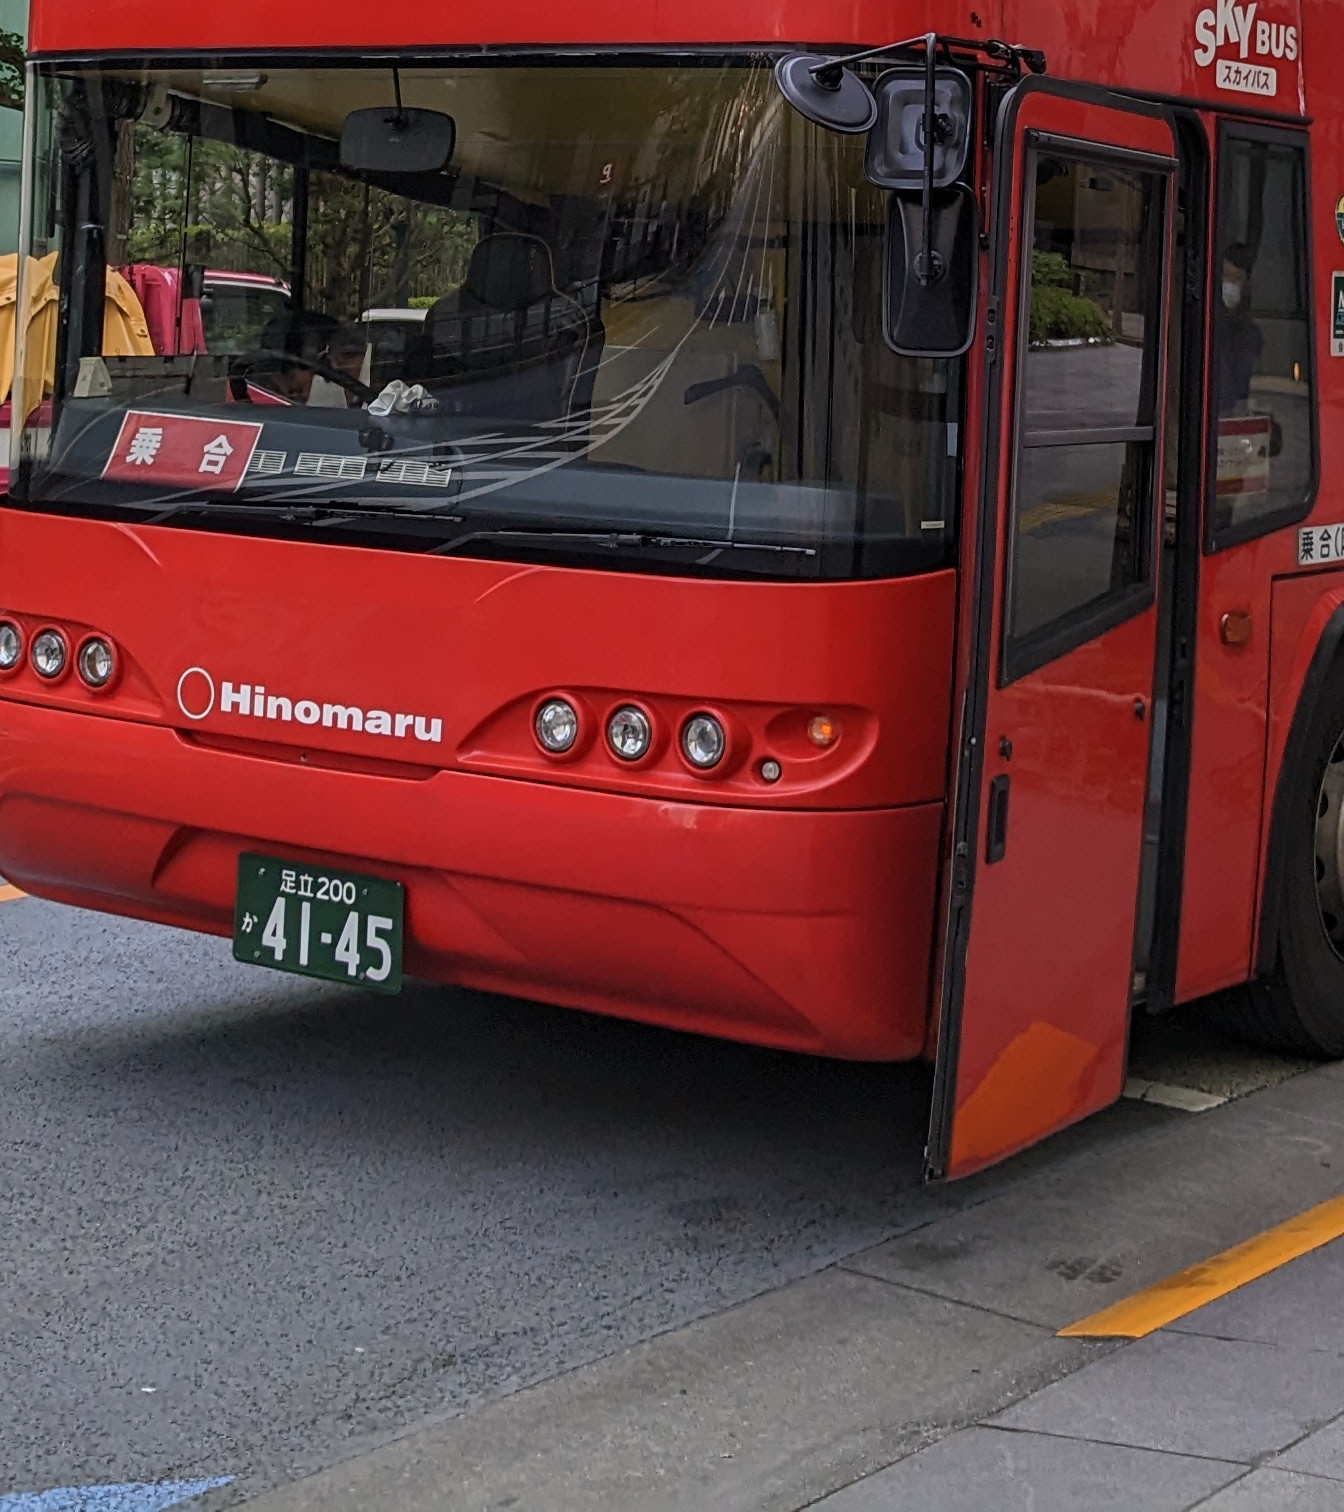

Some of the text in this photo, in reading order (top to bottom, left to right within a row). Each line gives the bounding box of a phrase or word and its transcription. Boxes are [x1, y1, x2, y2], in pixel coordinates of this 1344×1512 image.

[1256, 20, 1298, 61] BUS
[1222, 65, 1270, 91] スカイバス
[220, 681, 443, 743] Hinomaru
[240, 896, 394, 983] か 41-45
